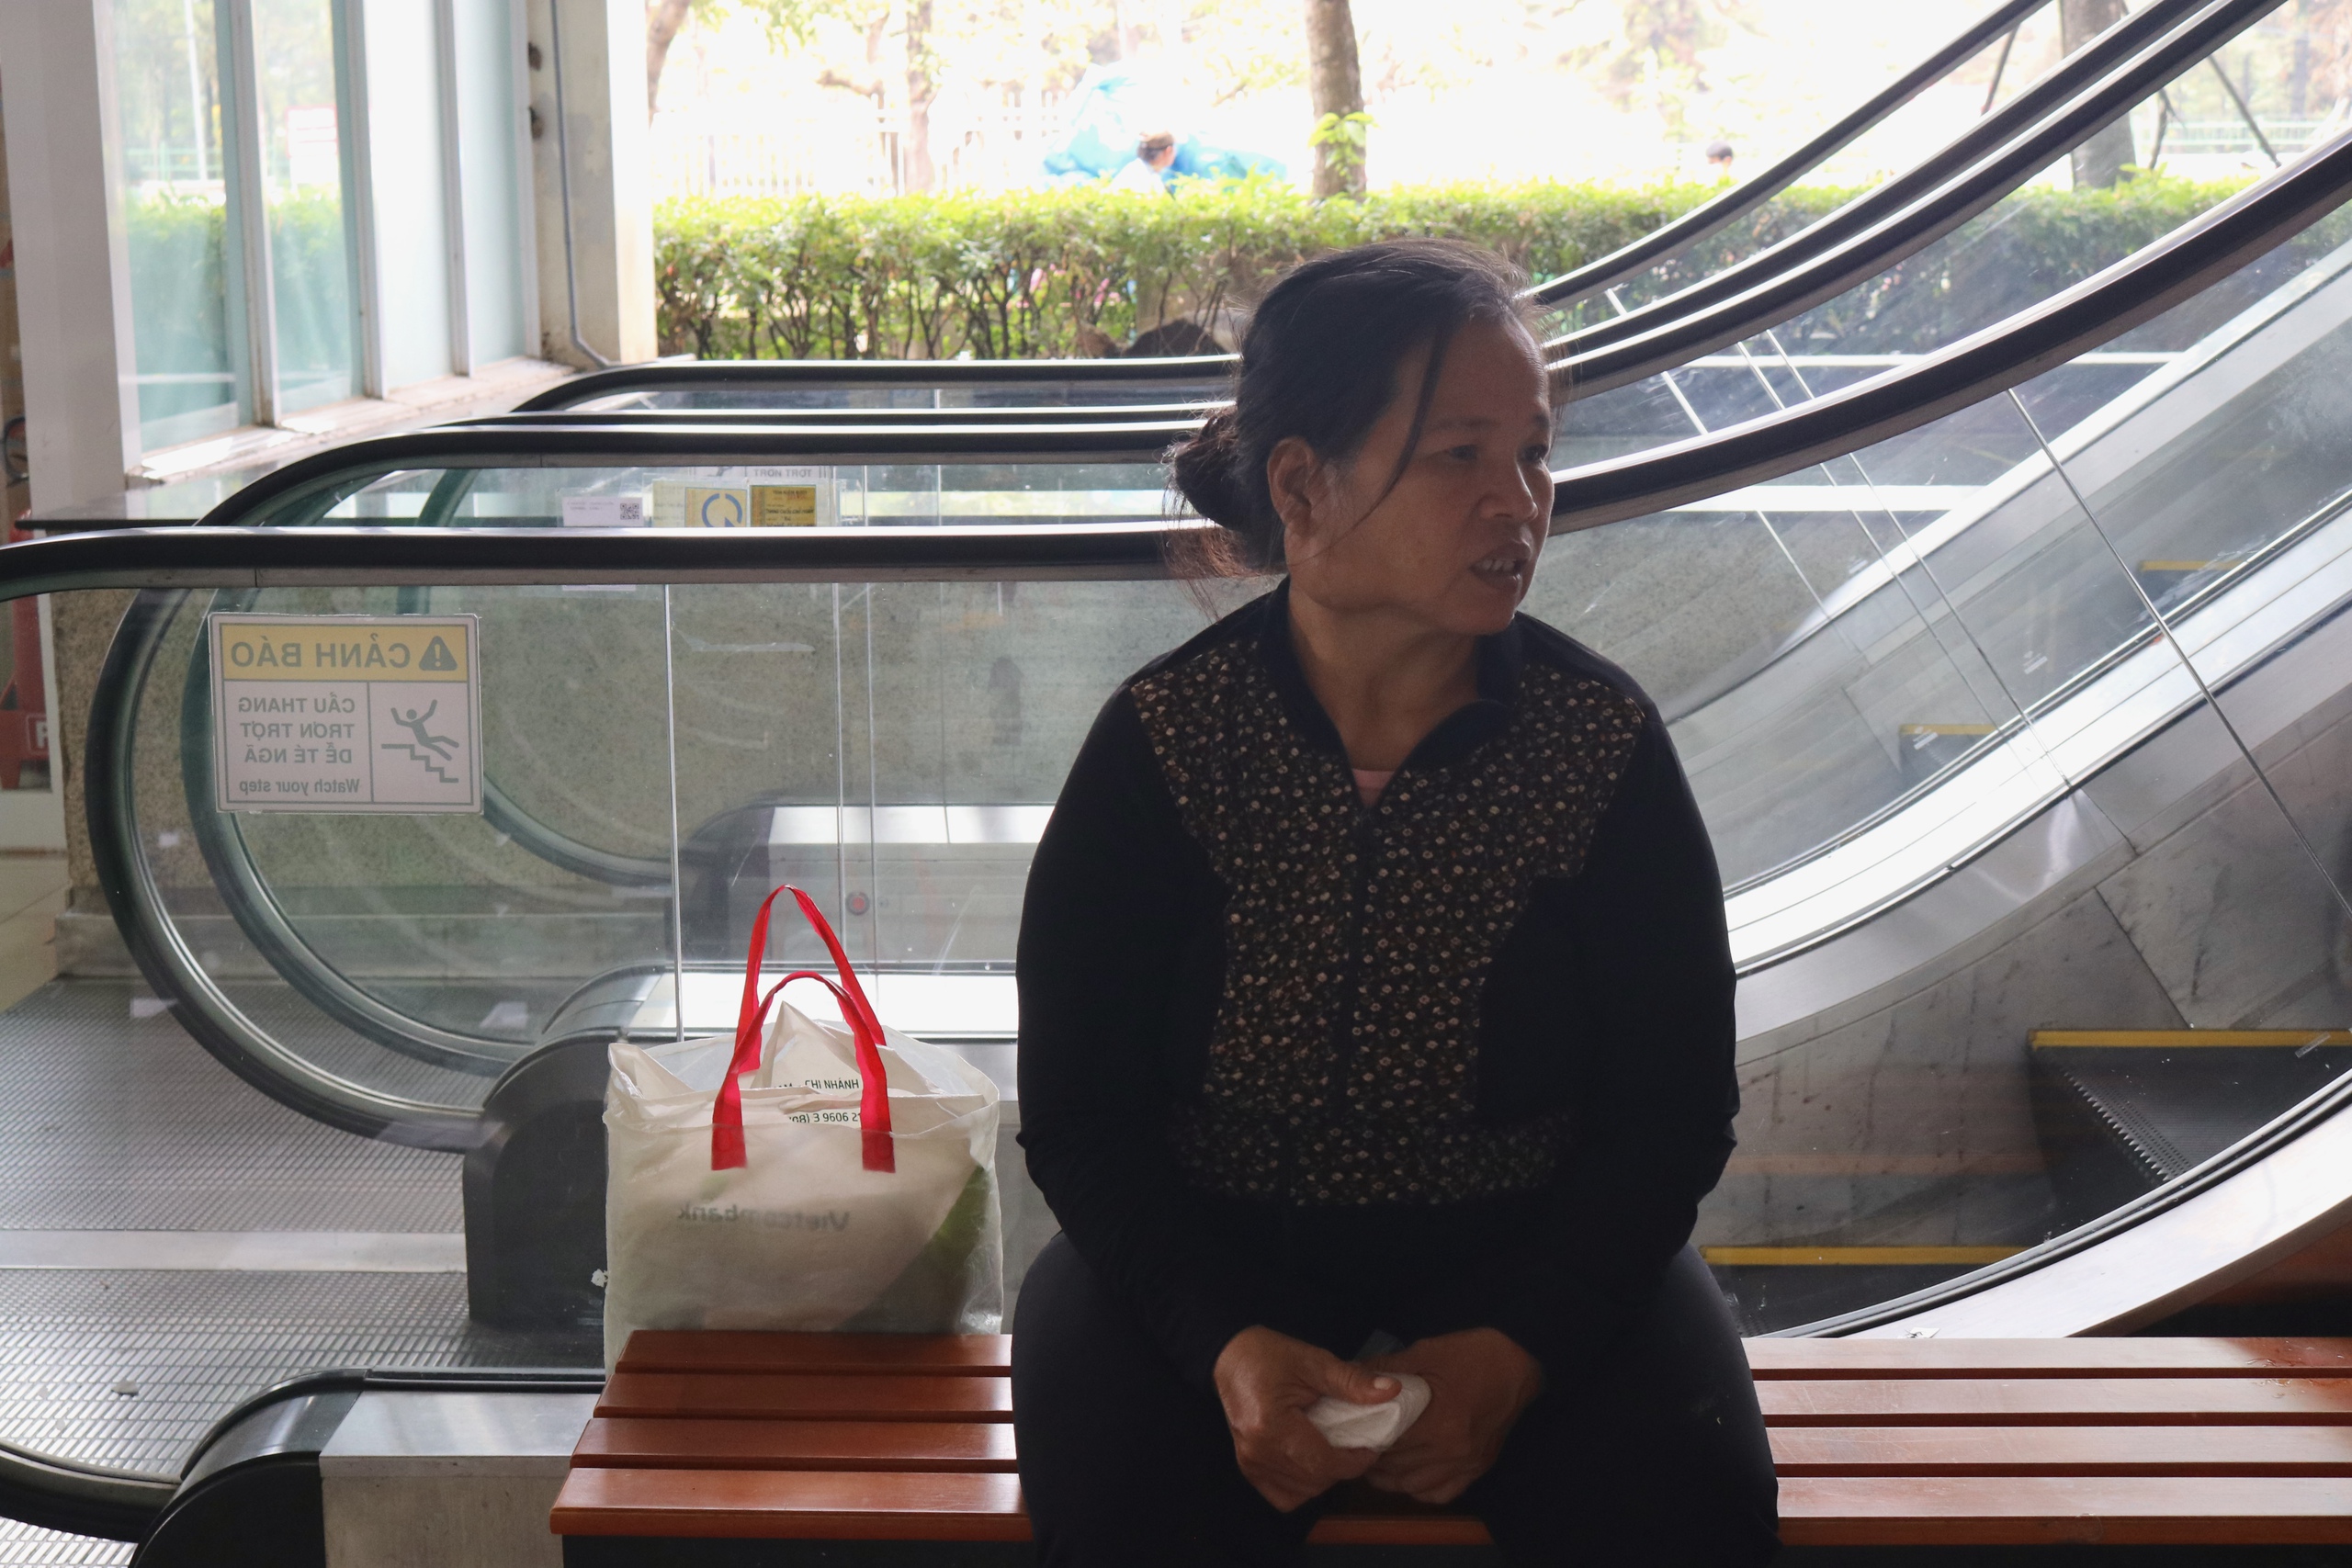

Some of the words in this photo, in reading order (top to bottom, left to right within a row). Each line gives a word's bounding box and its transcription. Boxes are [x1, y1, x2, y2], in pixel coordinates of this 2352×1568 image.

[823, 1077, 860, 1089] NHÁNH
[812, 1113, 820, 1122] 3
[822, 1112, 849, 1122] 9606
[851, 1112, 861, 1122] 2
